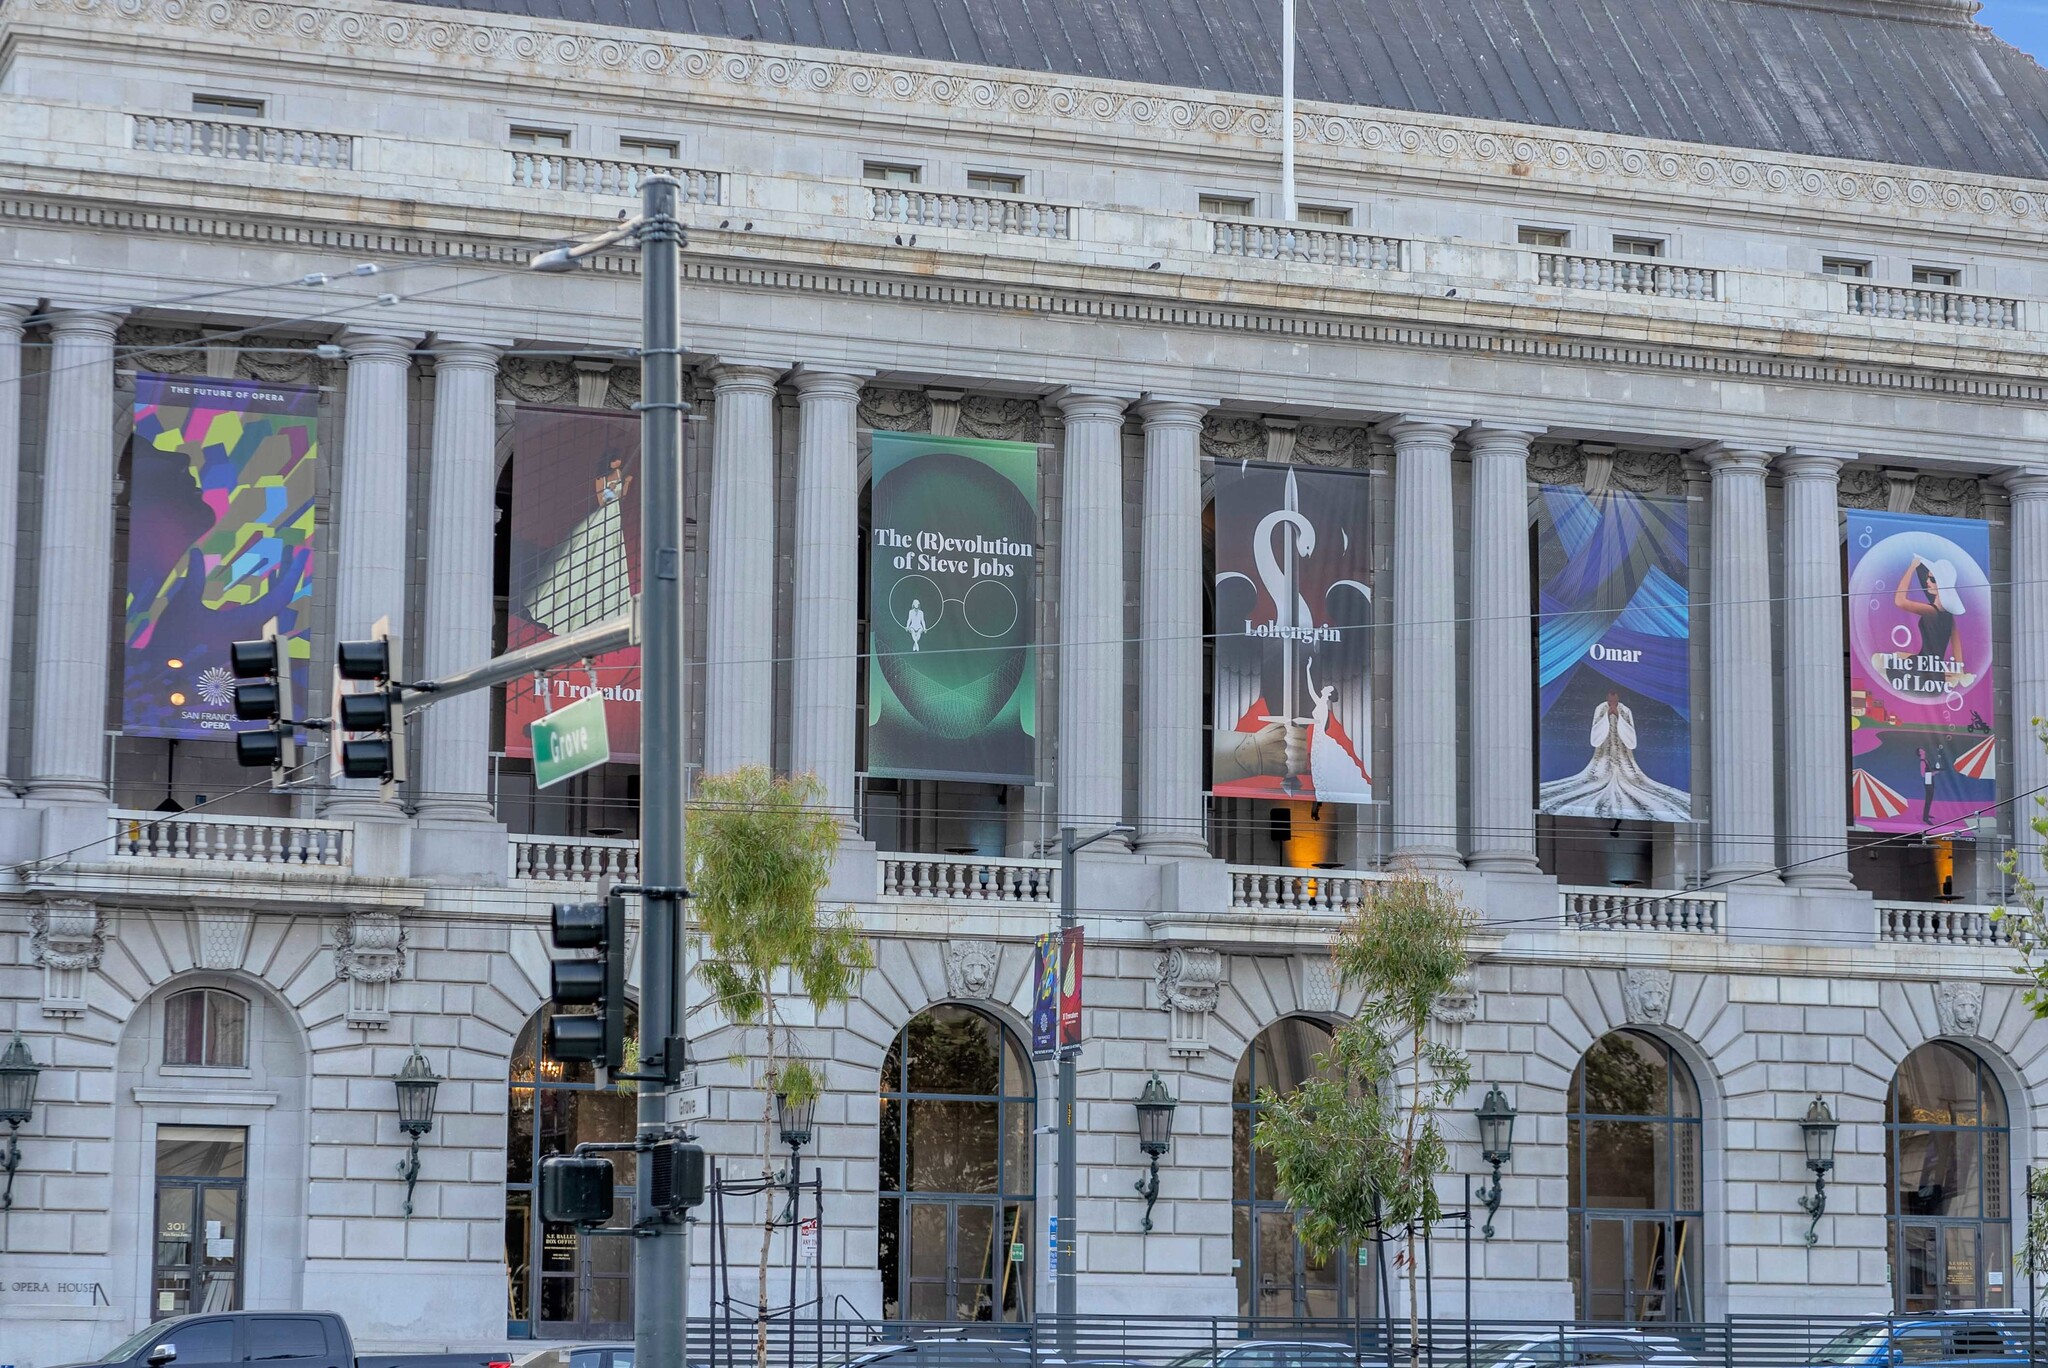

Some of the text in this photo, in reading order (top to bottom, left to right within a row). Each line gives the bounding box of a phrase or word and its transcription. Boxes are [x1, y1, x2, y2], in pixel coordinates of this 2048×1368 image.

[170, 386, 285, 402] THE FUTURE OF OPERA
[874, 528, 1033, 557] The (R)evolution
[893, 551, 1015, 578] of Steve Jobs
[1244, 619, 1341, 644] Lohengrin
[1589, 643, 1642, 663] Omar
[1880, 652, 1964, 673] The Elixir
[554, 680, 641, 701] Troator
[1892, 673, 1953, 693] of Love
[181, 711, 249, 723] SAN FRANCIS
[200, 721, 231, 730] OPERA
[550, 726, 588, 764] Grove
[679, 1097, 696, 1116] Grove
[166, 1222, 186, 1231] 301
[12, 1282, 50, 1293] OPERA
[57, 1282, 95, 1293] HOUSE
